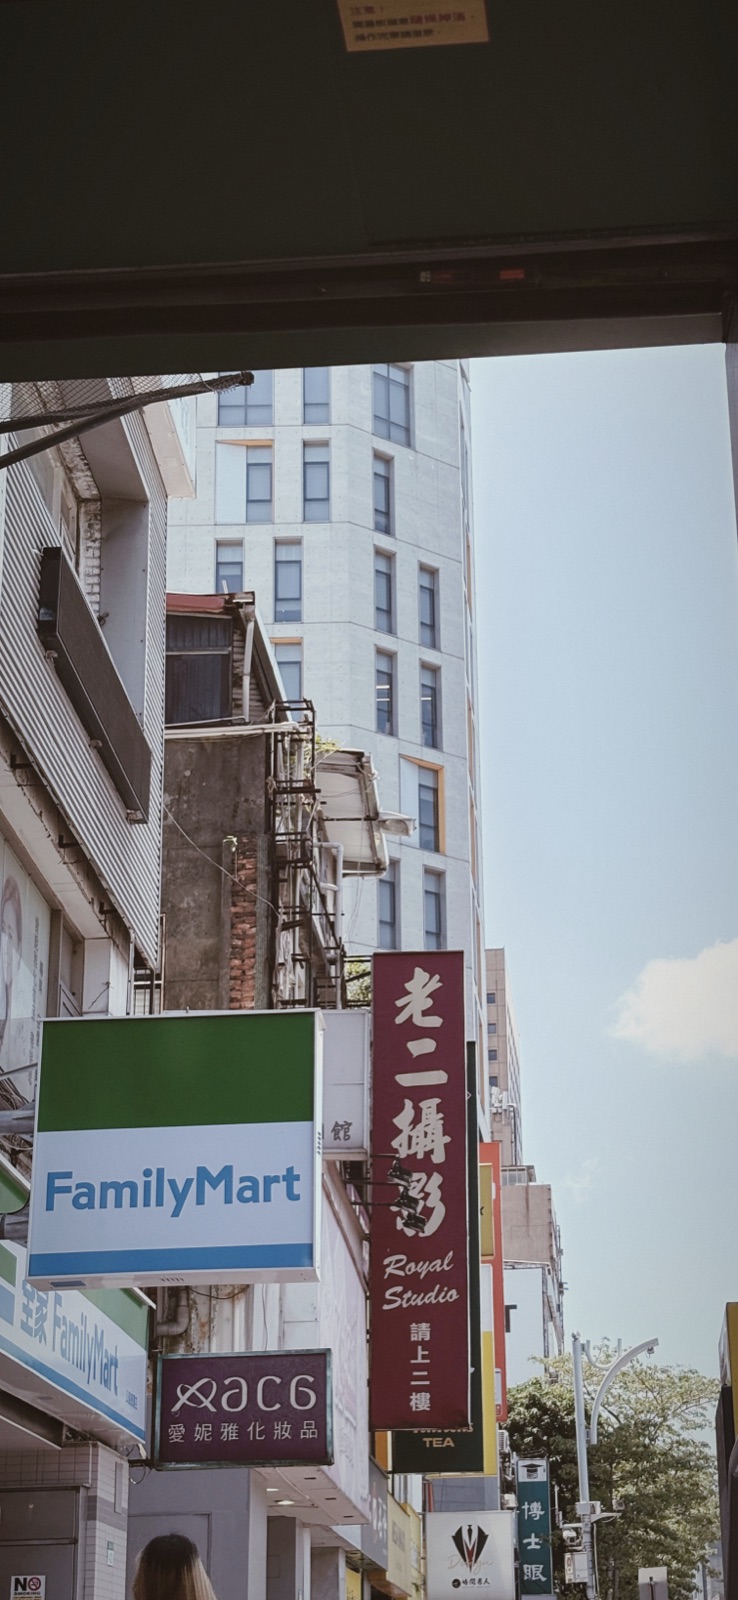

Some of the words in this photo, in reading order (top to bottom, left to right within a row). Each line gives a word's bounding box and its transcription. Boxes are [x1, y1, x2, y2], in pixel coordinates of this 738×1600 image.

[322, 1120, 353, 1142] 館
[45, 1164, 301, 1218] FamilyMart
[382, 1250, 454, 1280] Royal
[382, 1284, 460, 1311] Studio
[52, 1291, 120, 1397] FamilyMart
[409, 1322, 431, 1412] 請上二樓
[168, 1420, 319, 1443] 愛妮雅化妝品
[423, 1437, 455, 1448] TEA
